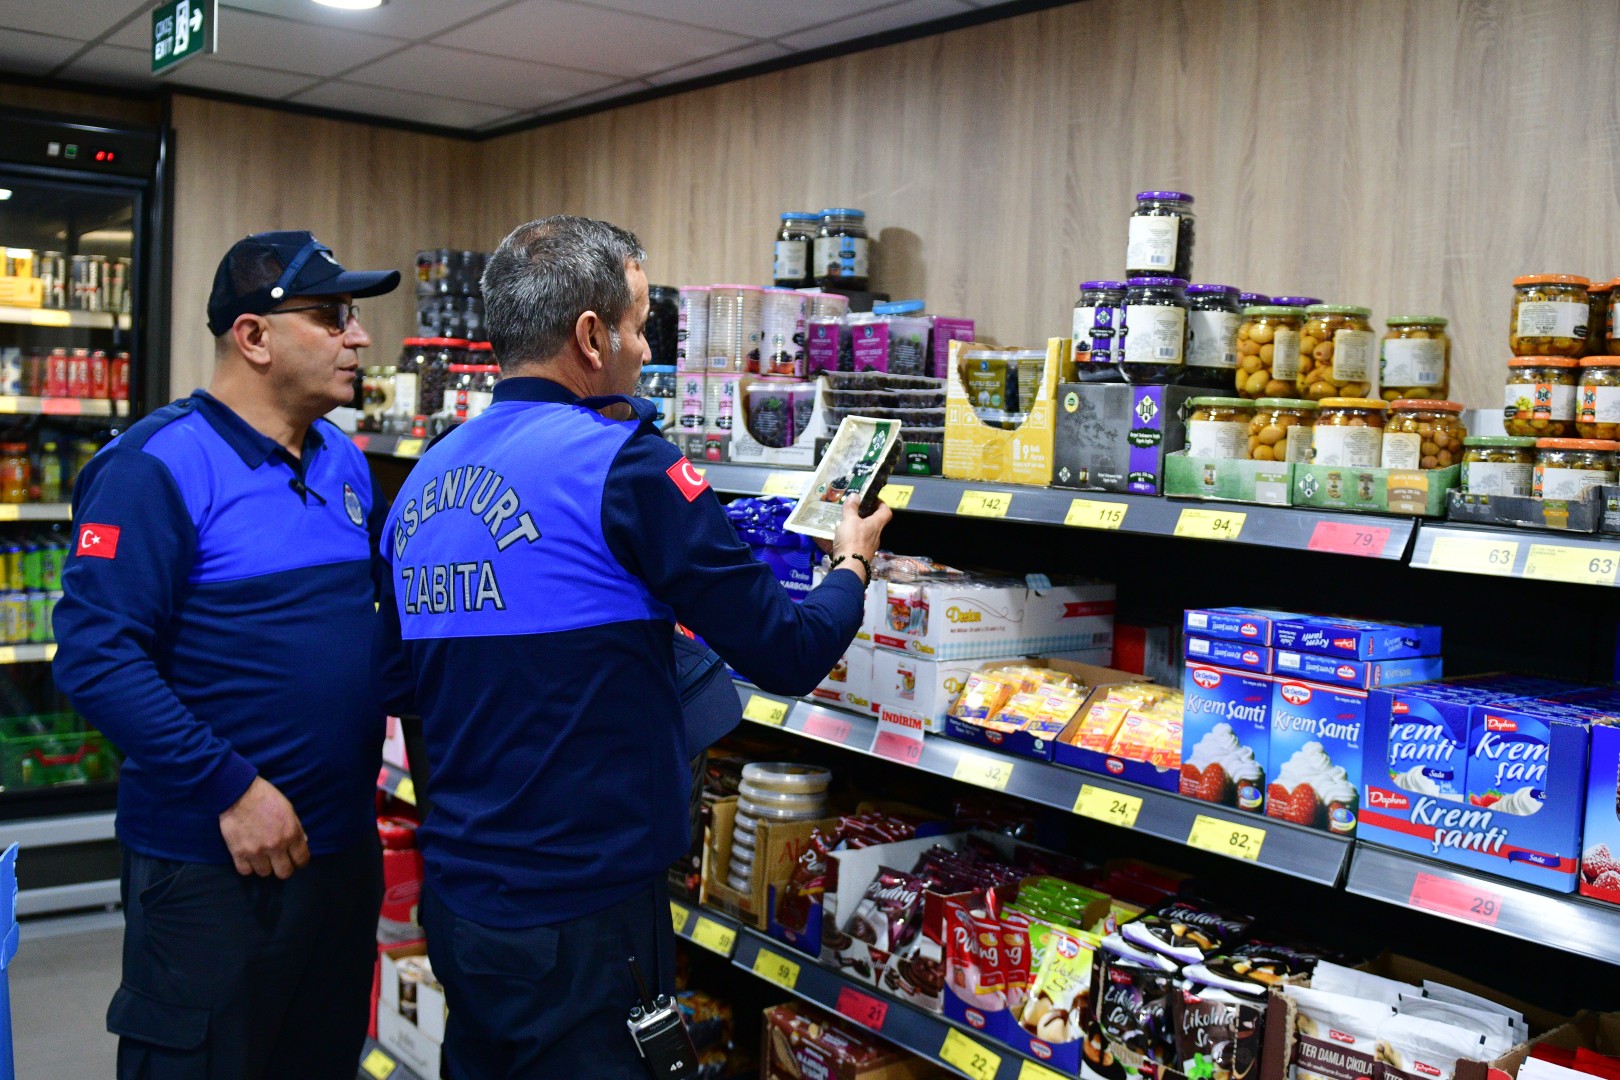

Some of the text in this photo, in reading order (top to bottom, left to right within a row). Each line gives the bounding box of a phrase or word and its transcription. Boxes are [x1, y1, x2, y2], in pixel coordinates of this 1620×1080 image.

[394, 464, 542, 561] ESENYURT
[402, 560, 507, 615] ZABITA
[882, 707, 923, 730] İNDİRİM
[1186, 693, 1266, 723] Krem Şanti
[1274, 709, 1360, 742] Krem Şanti
[1390, 723, 1443, 741] rem
[1487, 718, 1516, 730] Daphne
[1390, 740, 1457, 766] şanti
[1429, 770, 1445, 780] Sade
[1370, 791, 1407, 809] Daphne
[1410, 796, 1492, 830] Krem
[1432, 827, 1508, 854] şanti
[1529, 854, 1545, 864] Sade
[1317, 1047, 1345, 1068] DAMLA
[1345, 1055, 1373, 1076] ÇİKOLA
